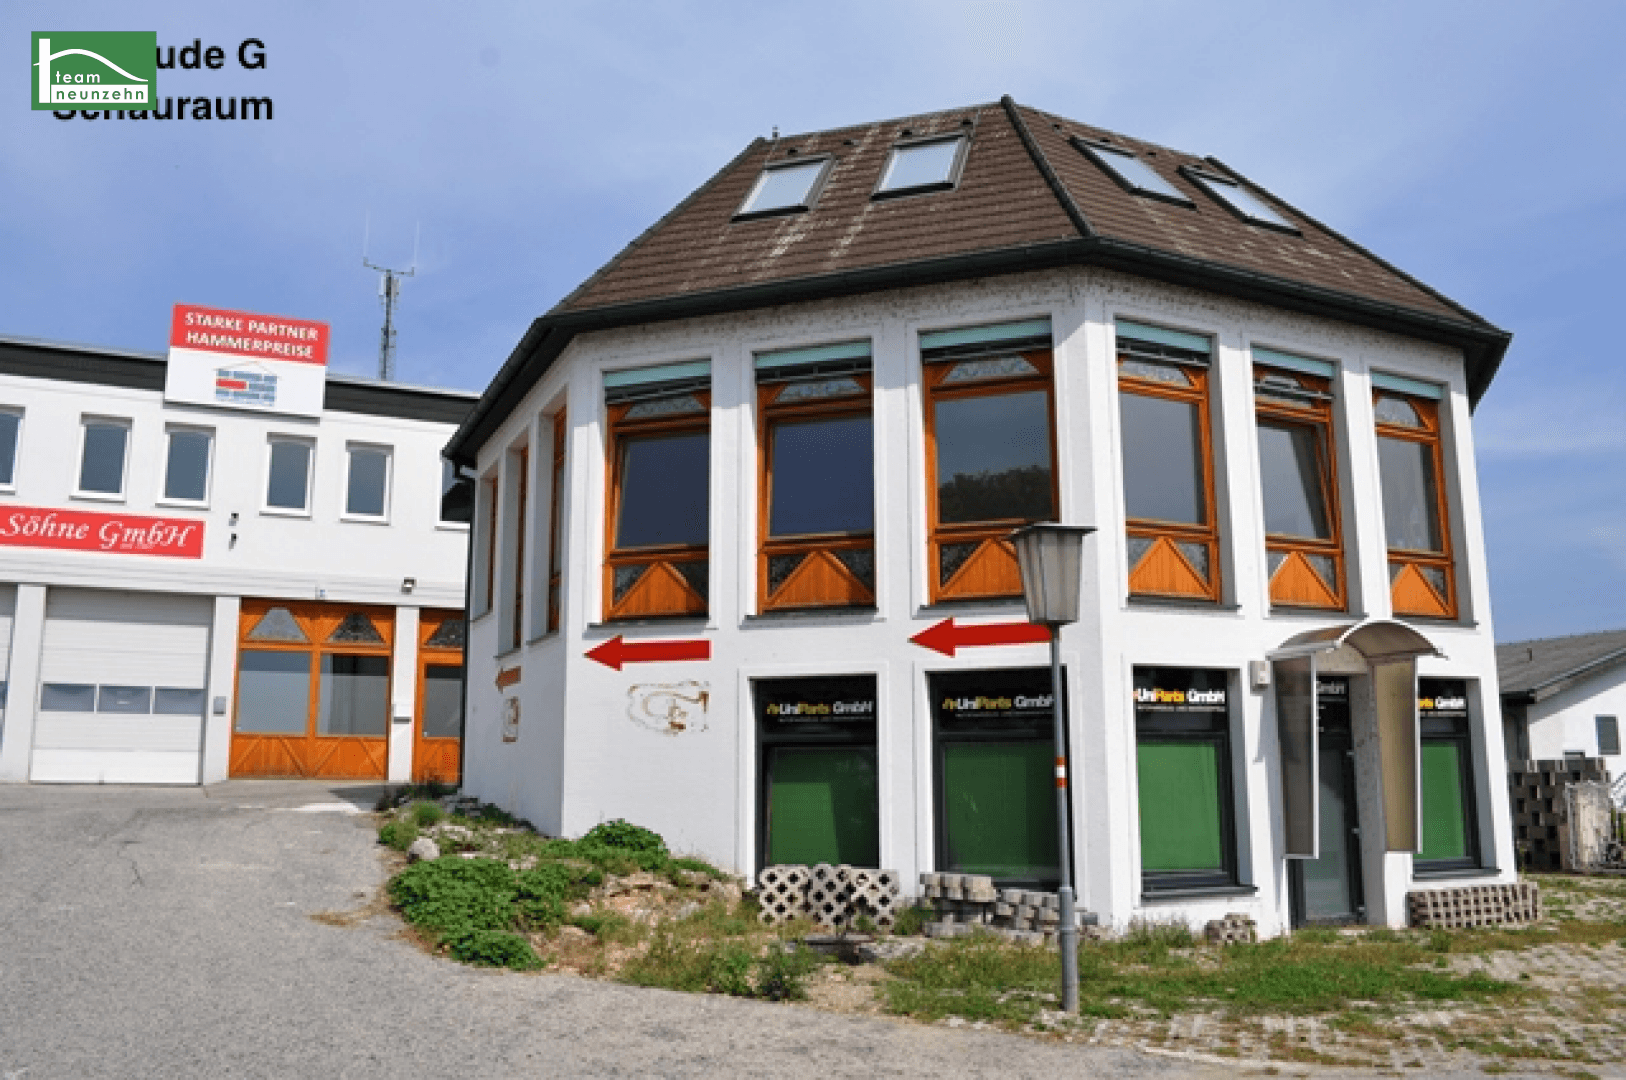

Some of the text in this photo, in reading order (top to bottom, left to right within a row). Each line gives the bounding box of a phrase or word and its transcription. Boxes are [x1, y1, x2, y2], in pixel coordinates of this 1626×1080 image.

[185, 311, 319, 342] STARKE PARTNER
[185, 330, 314, 359] HAMMERPREISE
[1, 512, 197, 550] Söhne GmbH
[832, 700, 874, 714] GmbH
[1186, 687, 1226, 704] GmbH
